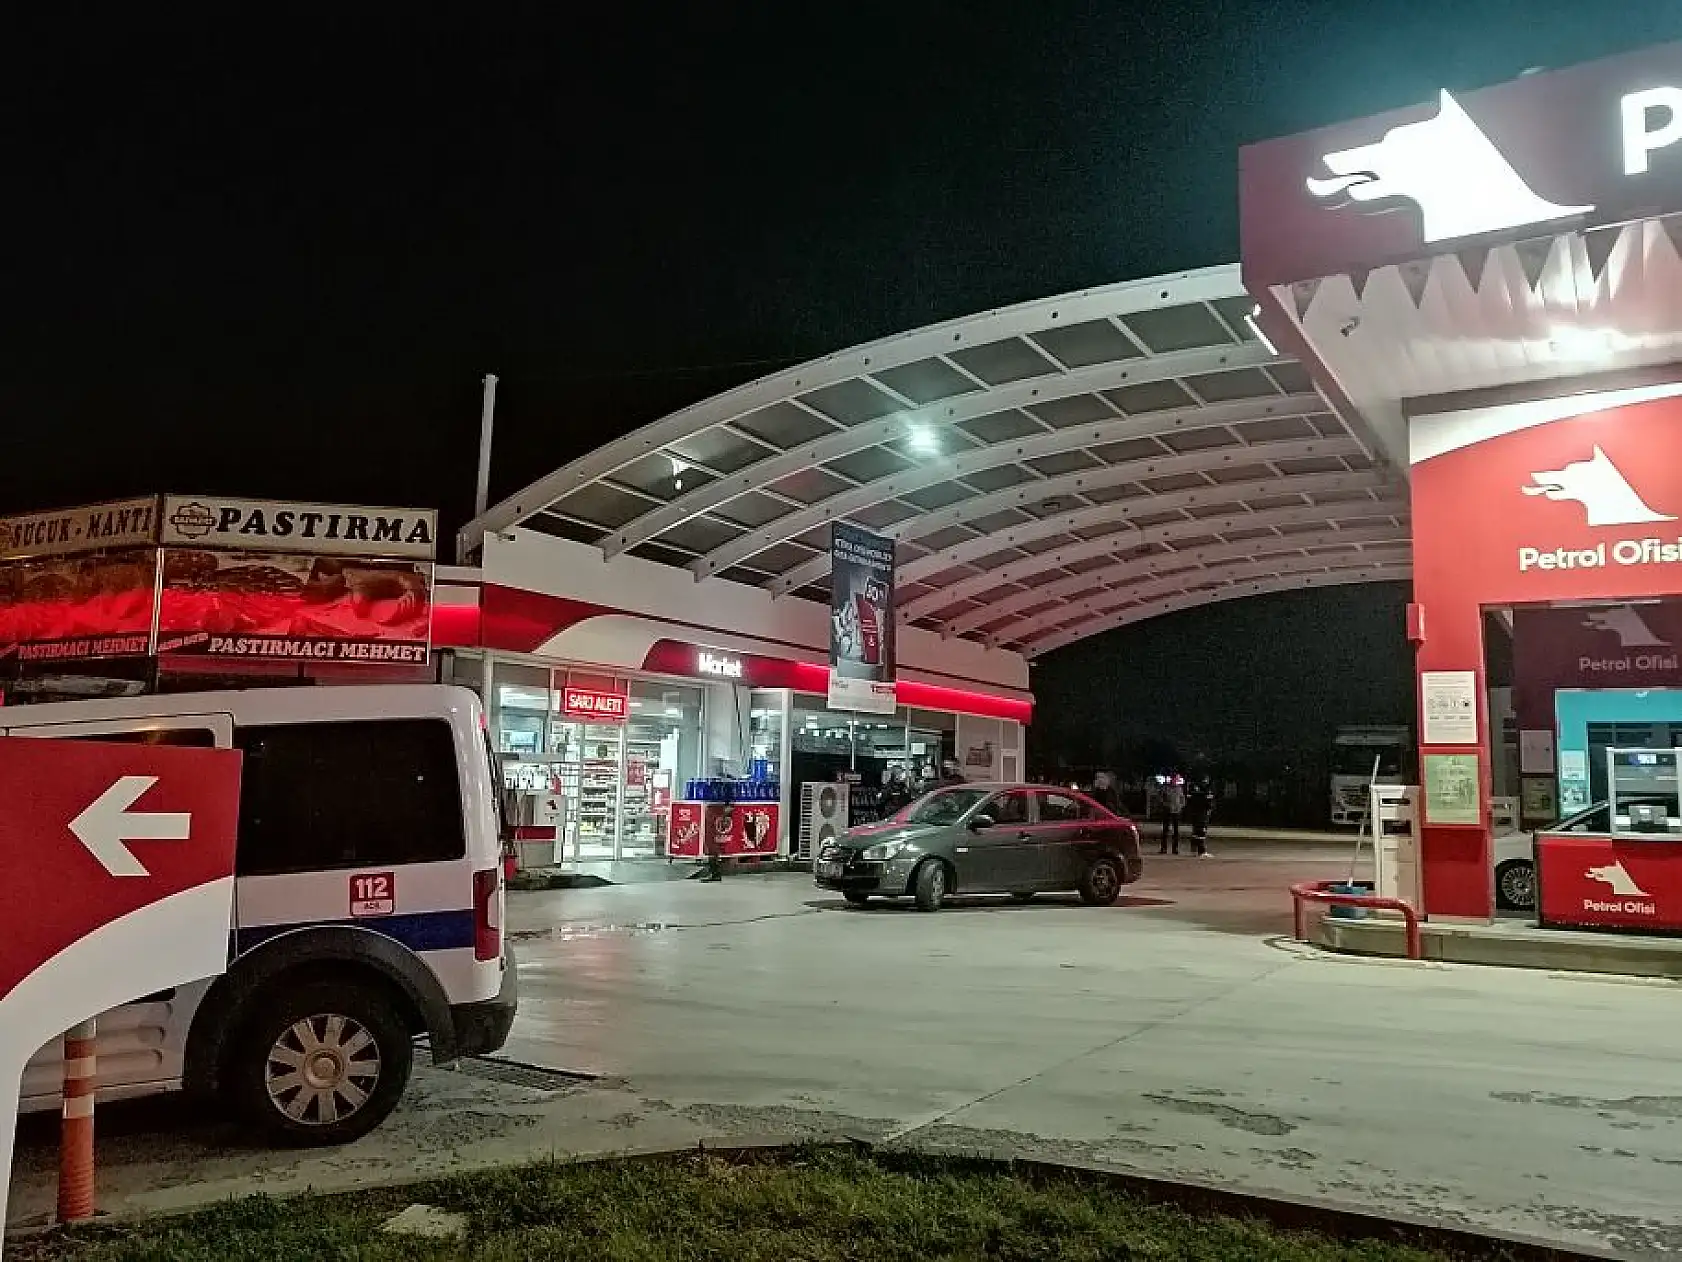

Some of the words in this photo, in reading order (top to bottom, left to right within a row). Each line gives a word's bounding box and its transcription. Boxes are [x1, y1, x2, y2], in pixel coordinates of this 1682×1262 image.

[1621, 86, 1682, 176] P
[216, 507, 432, 543] PASTIRMA
[1519, 542, 1606, 571] Petrol
[208, 637, 336, 658] PASTIRMACI
[339, 642, 426, 662] MEHMET
[1579, 656, 1631, 671] Petrol
[1635, 655, 1678, 670] Ofisi
[356, 877, 389, 899] 112
[1583, 899, 1622, 912] Petrol
[1624, 901, 1655, 914] Ofisi
